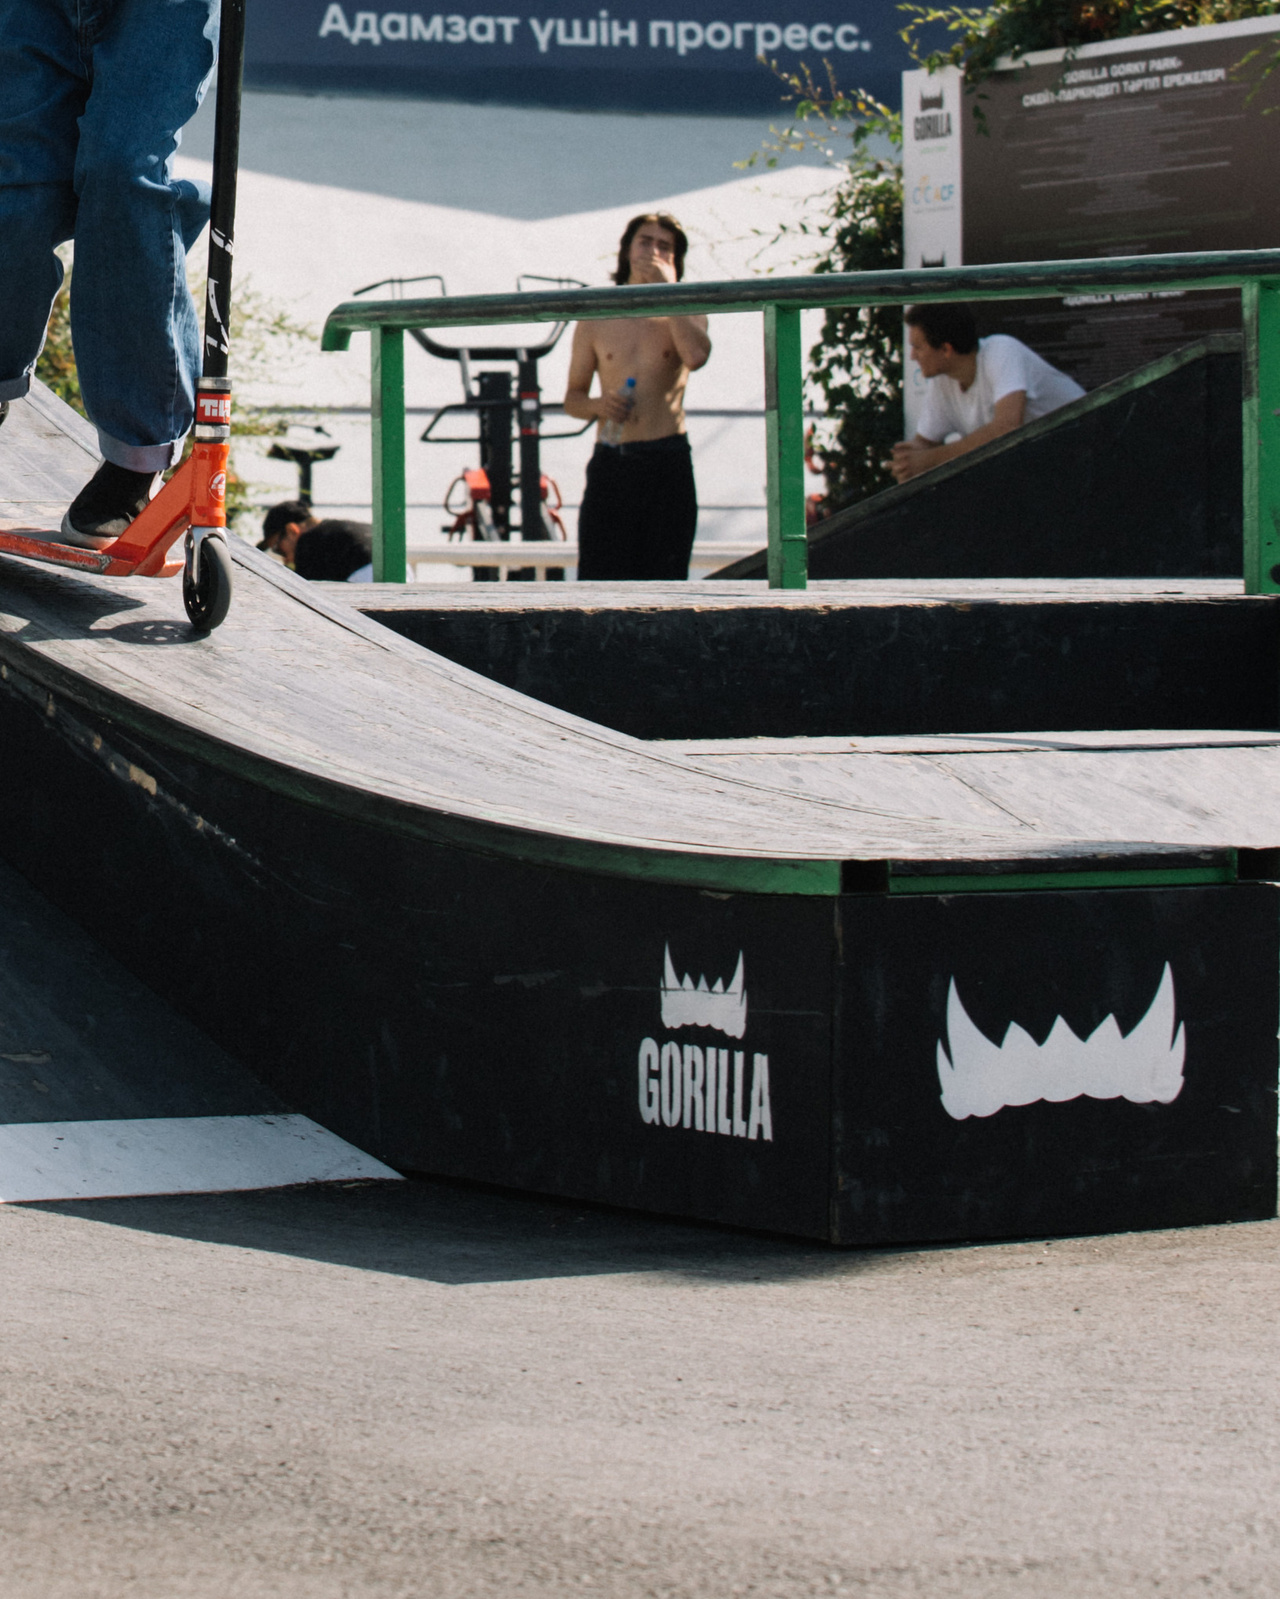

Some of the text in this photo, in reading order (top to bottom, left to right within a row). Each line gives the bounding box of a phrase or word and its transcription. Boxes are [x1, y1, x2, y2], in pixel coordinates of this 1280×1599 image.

[319, 2, 872, 57] Адамзат үшін прогресс.
[914, 112, 952, 141] GORILLA
[637, 1036, 774, 1143] GORILLA
